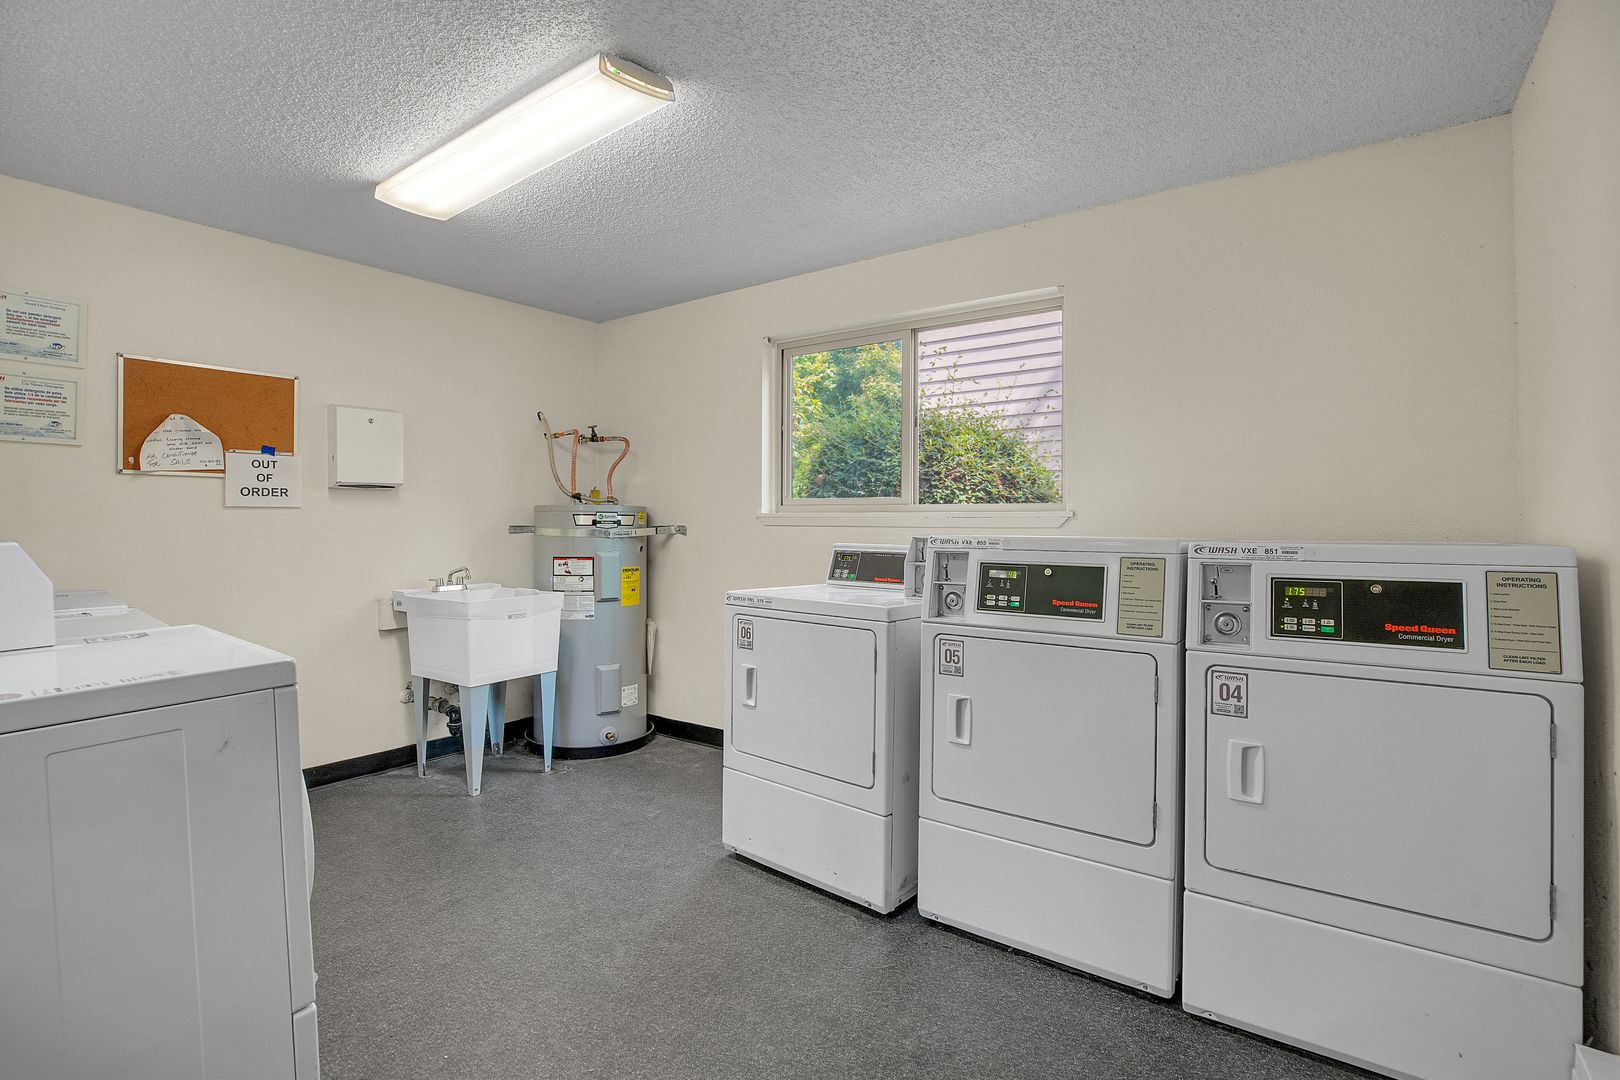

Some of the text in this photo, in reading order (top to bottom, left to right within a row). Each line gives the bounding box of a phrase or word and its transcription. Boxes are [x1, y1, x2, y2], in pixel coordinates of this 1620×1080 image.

[251, 460, 277, 469] OUT
[256, 474, 273, 482] OF
[240, 487, 289, 497] ORDER
[741, 626, 751, 640] 06
[1385, 623, 1456, 634] Speed Queen
[1398, 633, 1434, 641] Commercial
[945, 649, 960, 664] 05
[1220, 683, 1243, 702] 04
